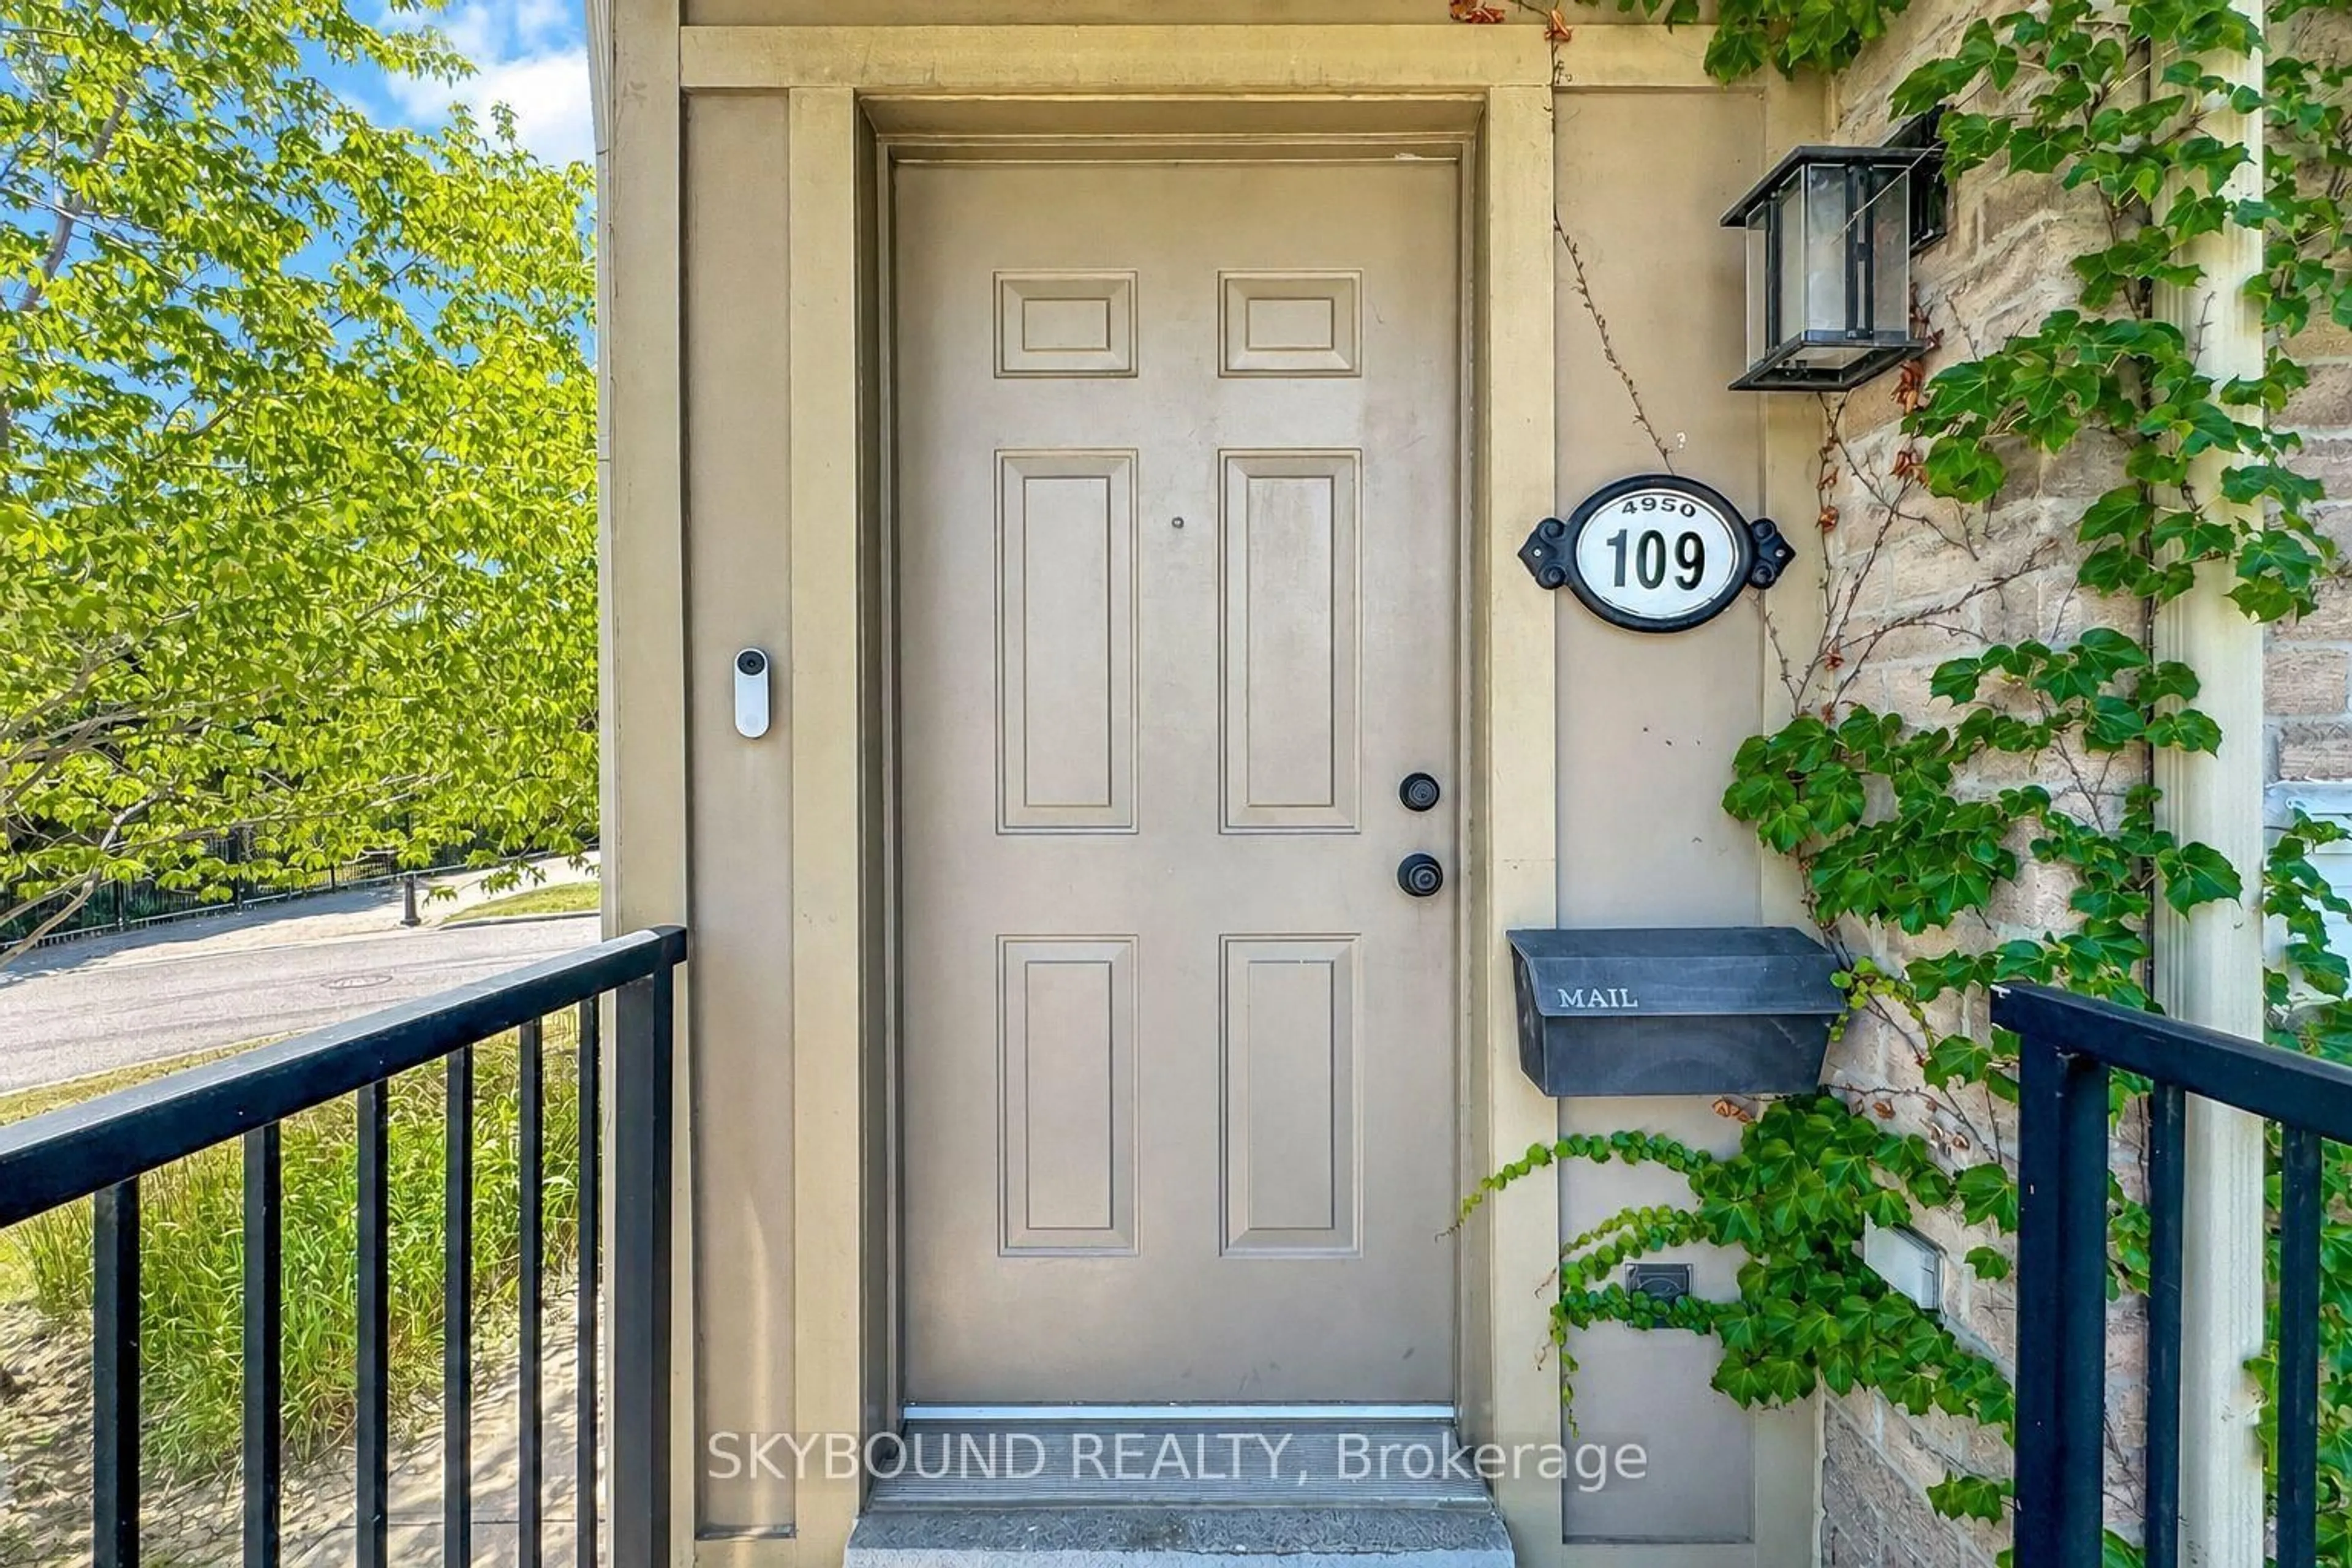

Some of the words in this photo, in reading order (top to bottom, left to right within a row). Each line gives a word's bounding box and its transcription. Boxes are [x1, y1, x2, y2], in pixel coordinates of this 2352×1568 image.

[1622, 497, 1695, 517] 4950
[1607, 529, 1705, 590] 109
[1558, 988, 1638, 1008] MAIL
